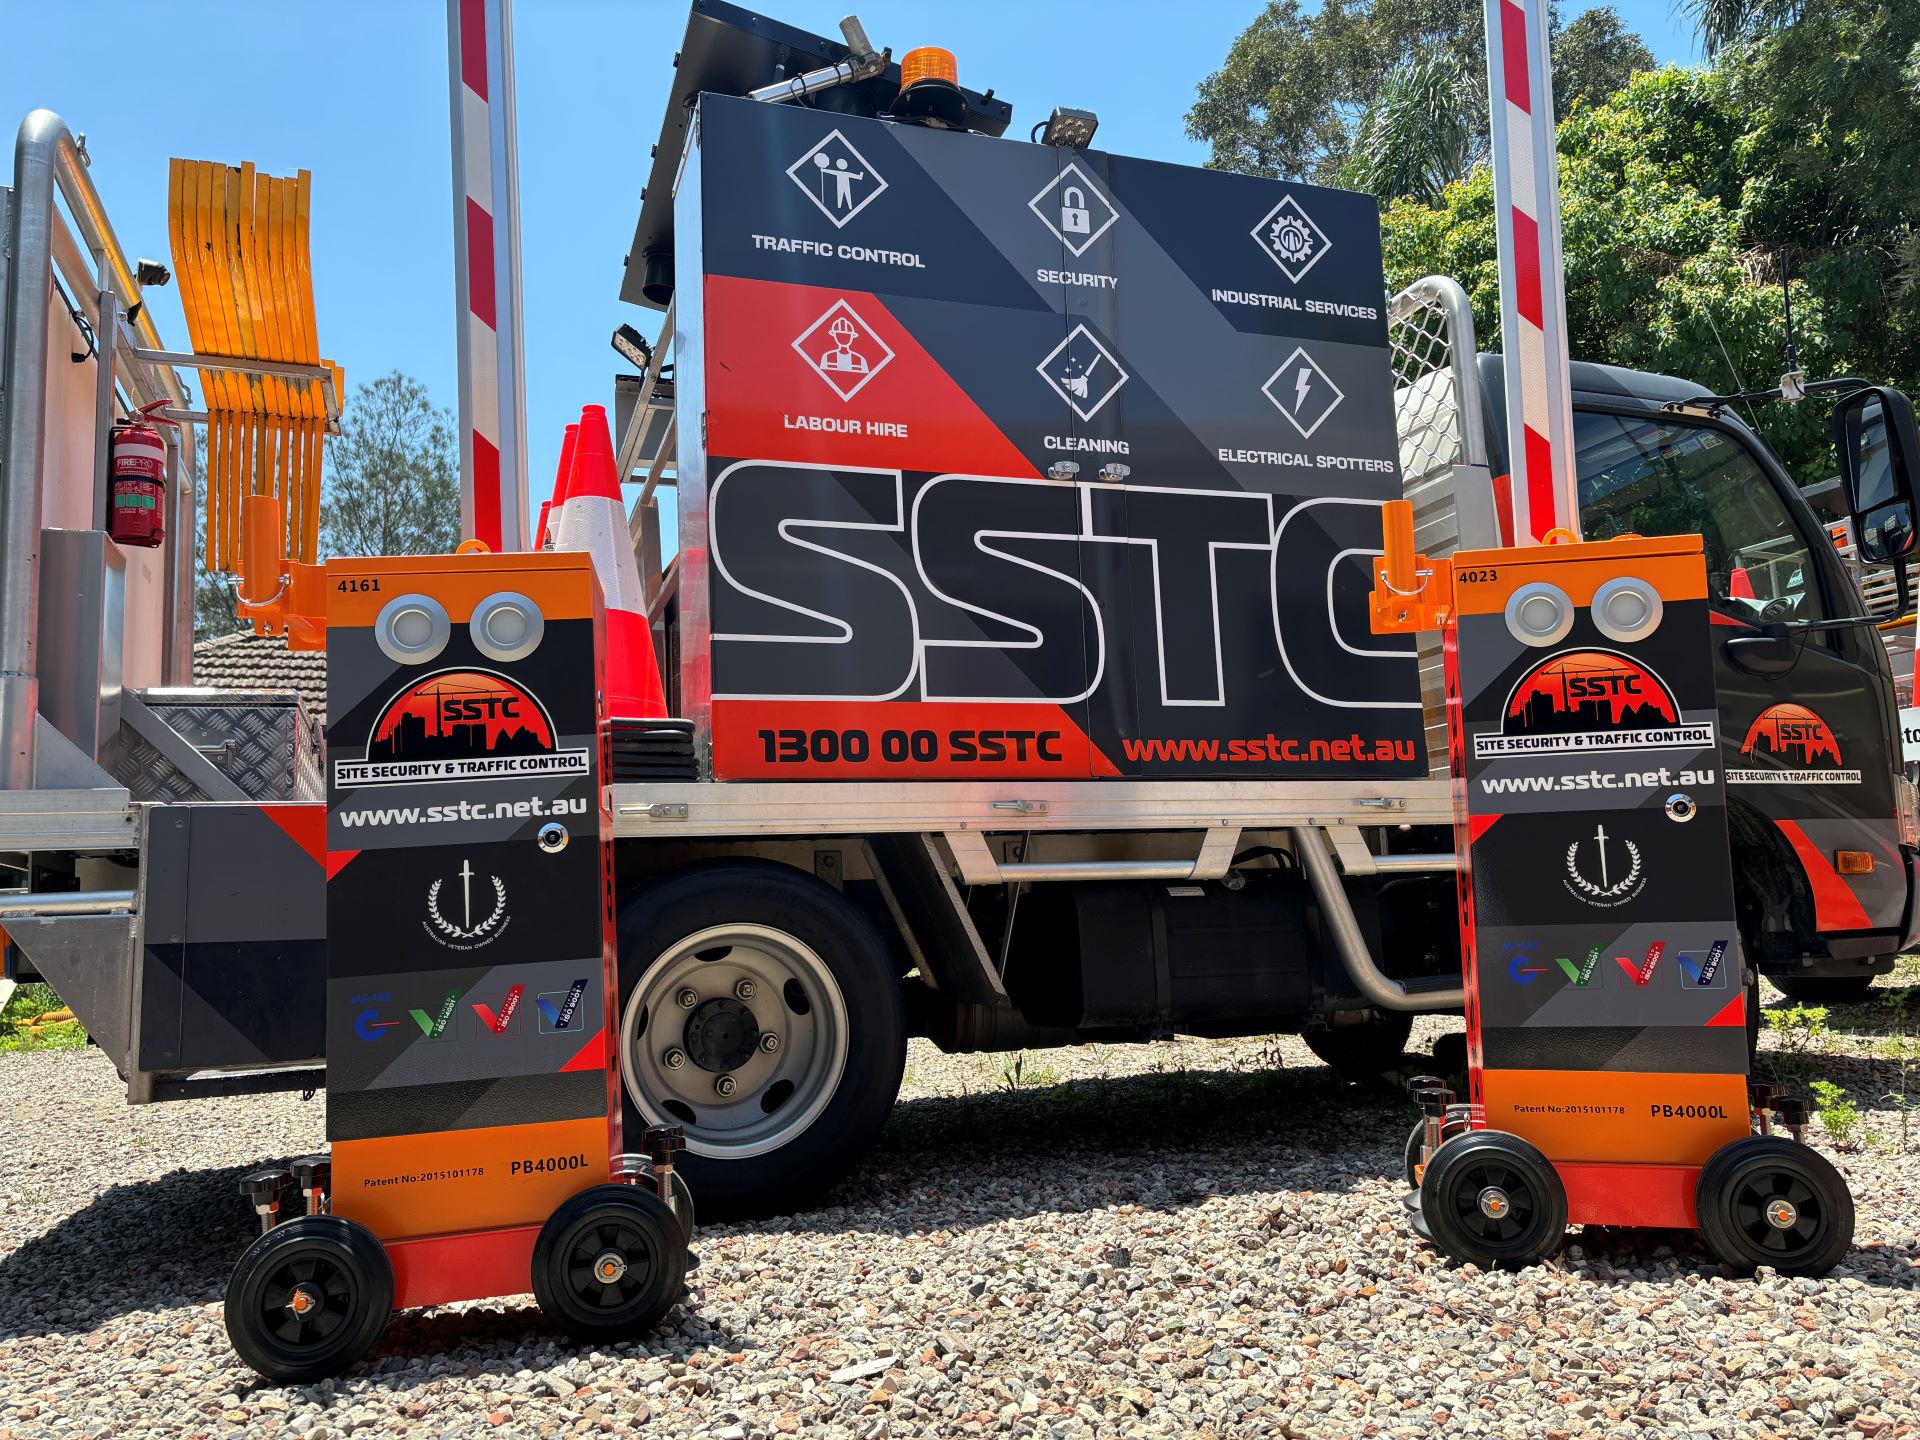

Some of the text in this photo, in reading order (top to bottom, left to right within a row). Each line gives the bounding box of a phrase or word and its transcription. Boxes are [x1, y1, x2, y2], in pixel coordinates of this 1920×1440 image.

[751, 234, 926, 269] TRAFFIC CONTROL
[1036, 269, 1119, 290] SECURITY
[1211, 289, 1378, 321] INDUSTRIAL SERVICES
[783, 414, 909, 439] LABOUR HIRE
[1043, 435, 1130, 456] CLEANING
[117, 458, 153, 469] FIREPRO
[1217, 448, 1394, 474] ELECTRICAL SPOTTERS
[337, 578, 381, 593] 4161
[709, 459, 1422, 709] SSTC
[1458, 569, 1498, 584] 4023
[1569, 674, 1644, 698] SSTC
[443, 696, 520, 722] SSTC
[1476, 729, 1711, 751] SITE SECURITY & TRAFFIC CONTROL
[1779, 723, 1823, 741] SSTC
[1902, 727, 1920, 744] tc
[757, 728, 1063, 763] 1300 00 SSTC
[1121, 732, 1416, 763] www.sstc.net.au
[336, 755, 586, 780] SITE SECURITY & TRAFFIC CONTROL
[1726, 772, 1861, 782] SITE SECURITY & TRAFFIC CONTROL
[1481, 767, 1715, 794] www.sstc.net.au
[340, 796, 587, 828] www.sstc.net.au
[1563, 879, 1587, 902] AUSTRALIAN
[1588, 900, 1612, 908] VETERAN
[422, 921, 447, 946] AUSTRALIAN
[447, 943, 473, 951] VETERAN
[474, 937, 494, 949] OWNED
[1583, 969, 1592, 981] ISO
[1644, 969, 1652, 981] ISO
[1705, 949, 1722, 980] ISO 9001
[437, 999, 456, 1033] ISO 14001
[501, 995, 520, 1028] ISO 45001
[563, 989, 582, 1023] ISO 9001
[1514, 1104, 1625, 1114] Patent No:2015101178
[1650, 1104, 1728, 1119] PB4000L
[511, 1153, 589, 1176] PB4000L
[364, 1167, 485, 1188] Patent No:2015101178
